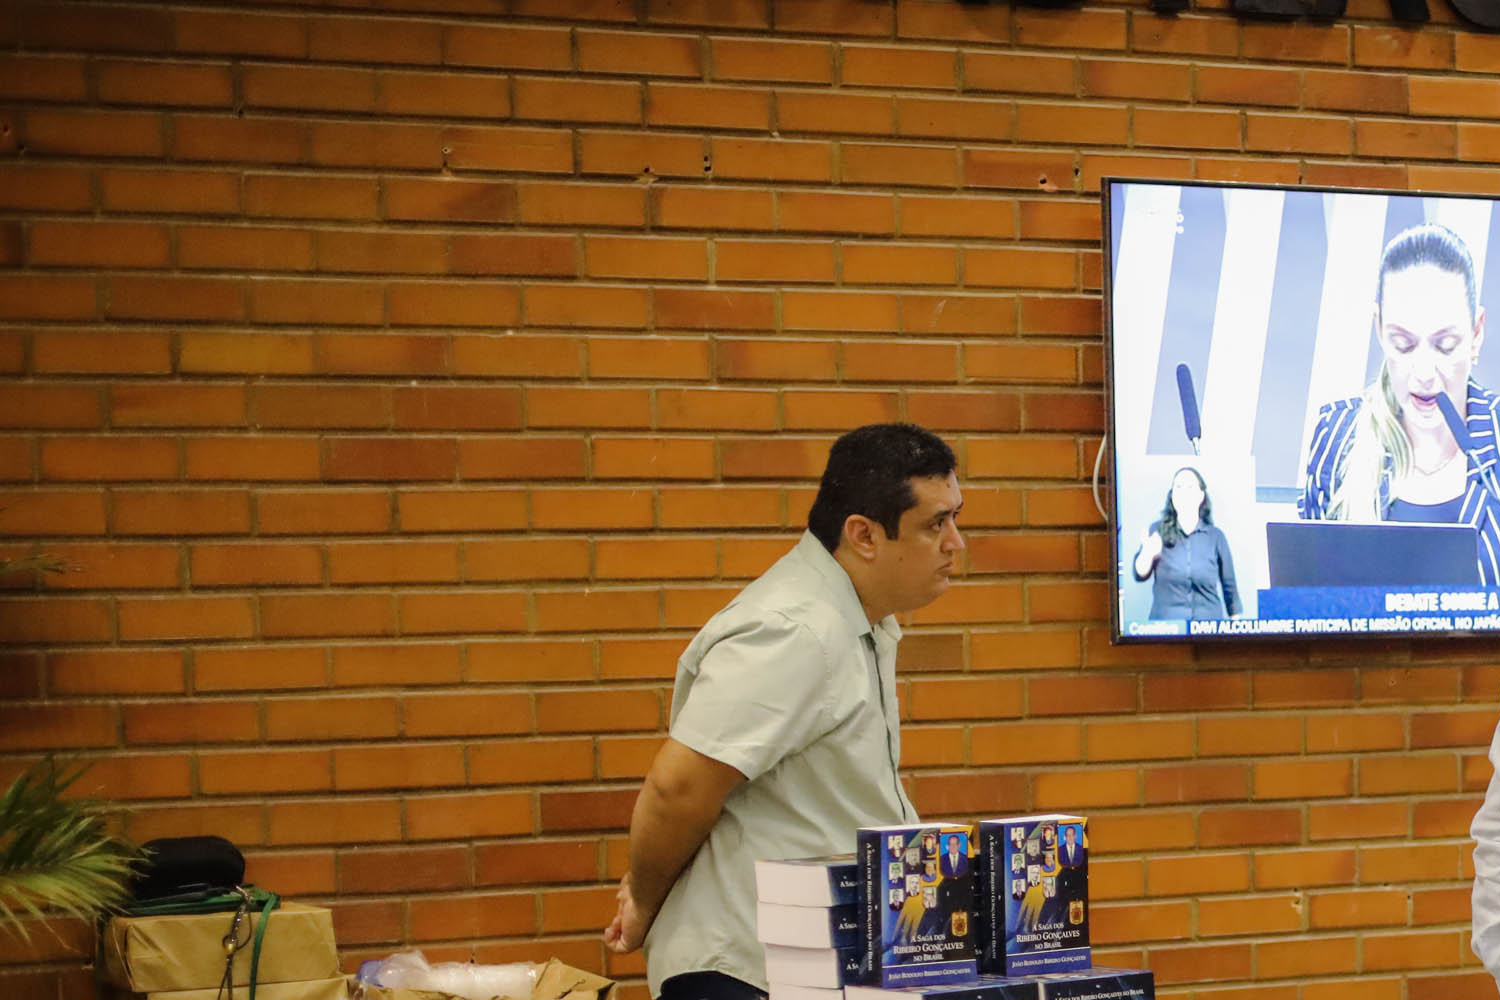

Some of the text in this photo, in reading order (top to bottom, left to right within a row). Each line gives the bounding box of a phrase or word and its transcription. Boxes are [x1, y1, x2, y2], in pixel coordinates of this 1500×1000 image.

[1385, 593, 1438, 611] DEBATE
[1440, 593, 1487, 611] SOBRE
[1488, 592, 1499, 610] A
[1190, 621, 1217, 634] DAVI
[1218, 620, 1294, 633] ALCOLUMBRE
[1296, 618, 1351, 633] PARTICIPA
[1352, 618, 1368, 631] DE
[1369, 615, 1410, 631] MISSÃO
[1412, 618, 1453, 630] OFICIAL
[1455, 617, 1472, 630] NO
[1016, 930, 1080, 943] RIBEIRO GONÇALVES
[893, 941, 965, 955] RIBEIRO GONÇALVES
